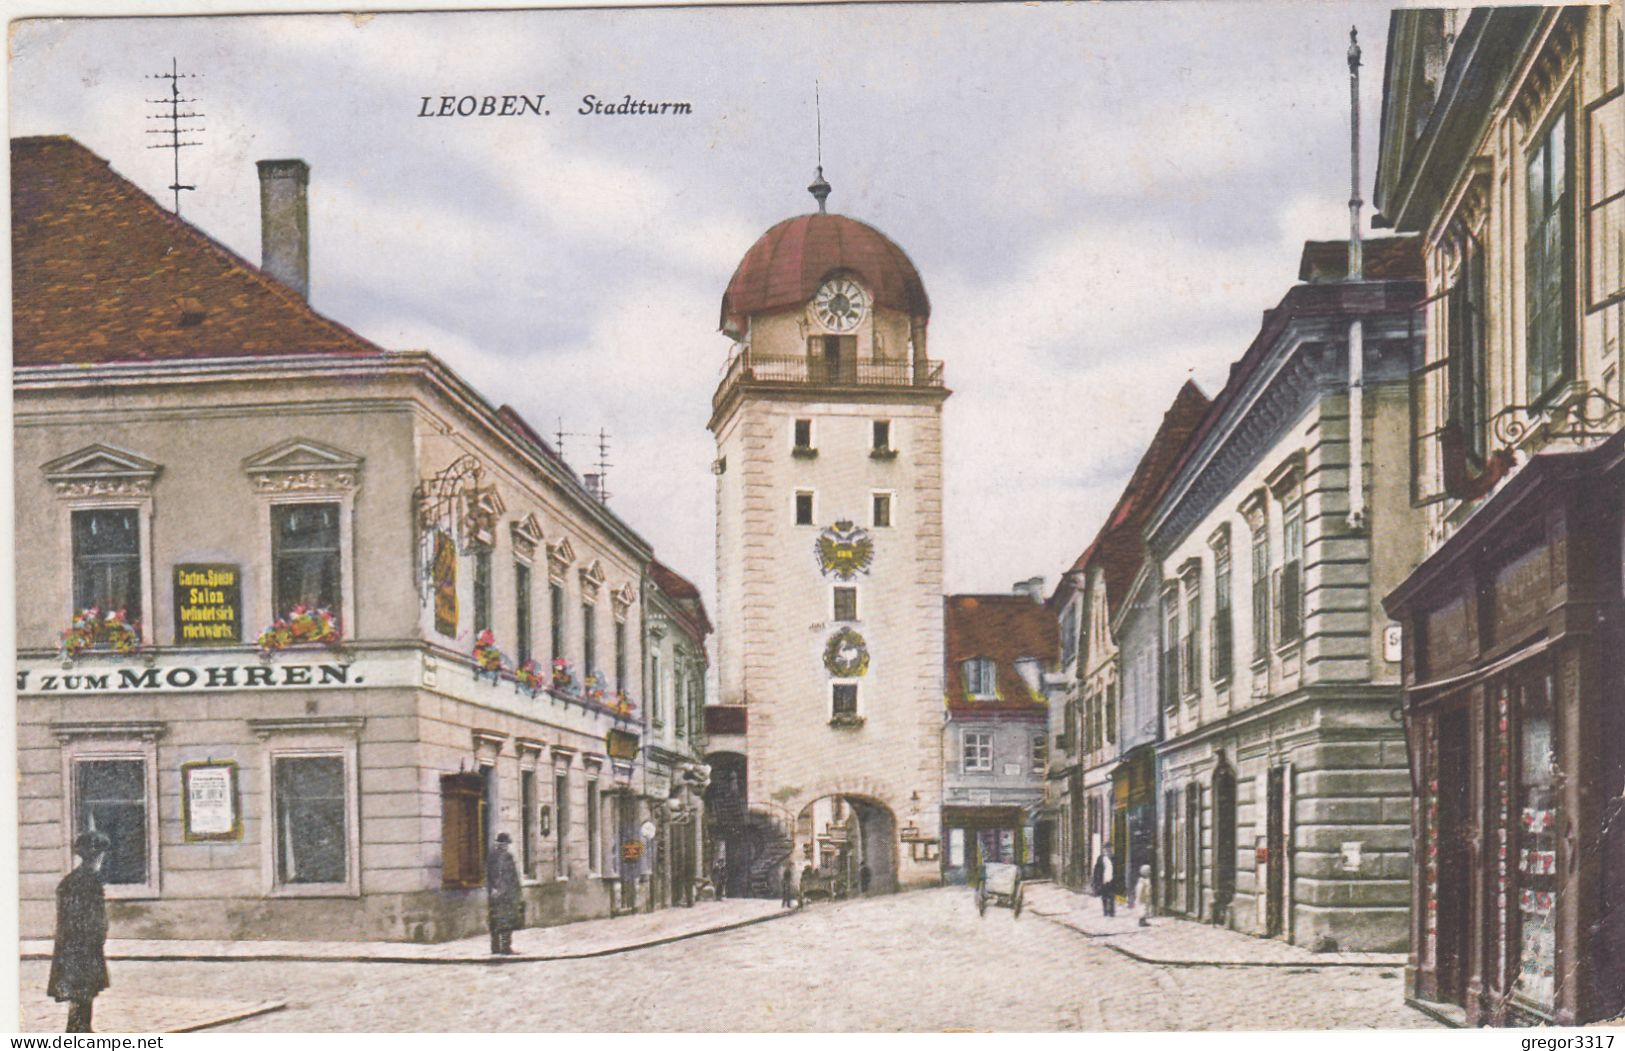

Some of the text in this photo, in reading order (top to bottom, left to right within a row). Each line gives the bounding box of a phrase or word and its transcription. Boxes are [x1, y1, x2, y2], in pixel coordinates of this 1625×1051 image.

[190, 588, 225, 605] Salon
[40, 675, 109, 691] ZUM
[117, 664, 365, 689] MOHREN.
